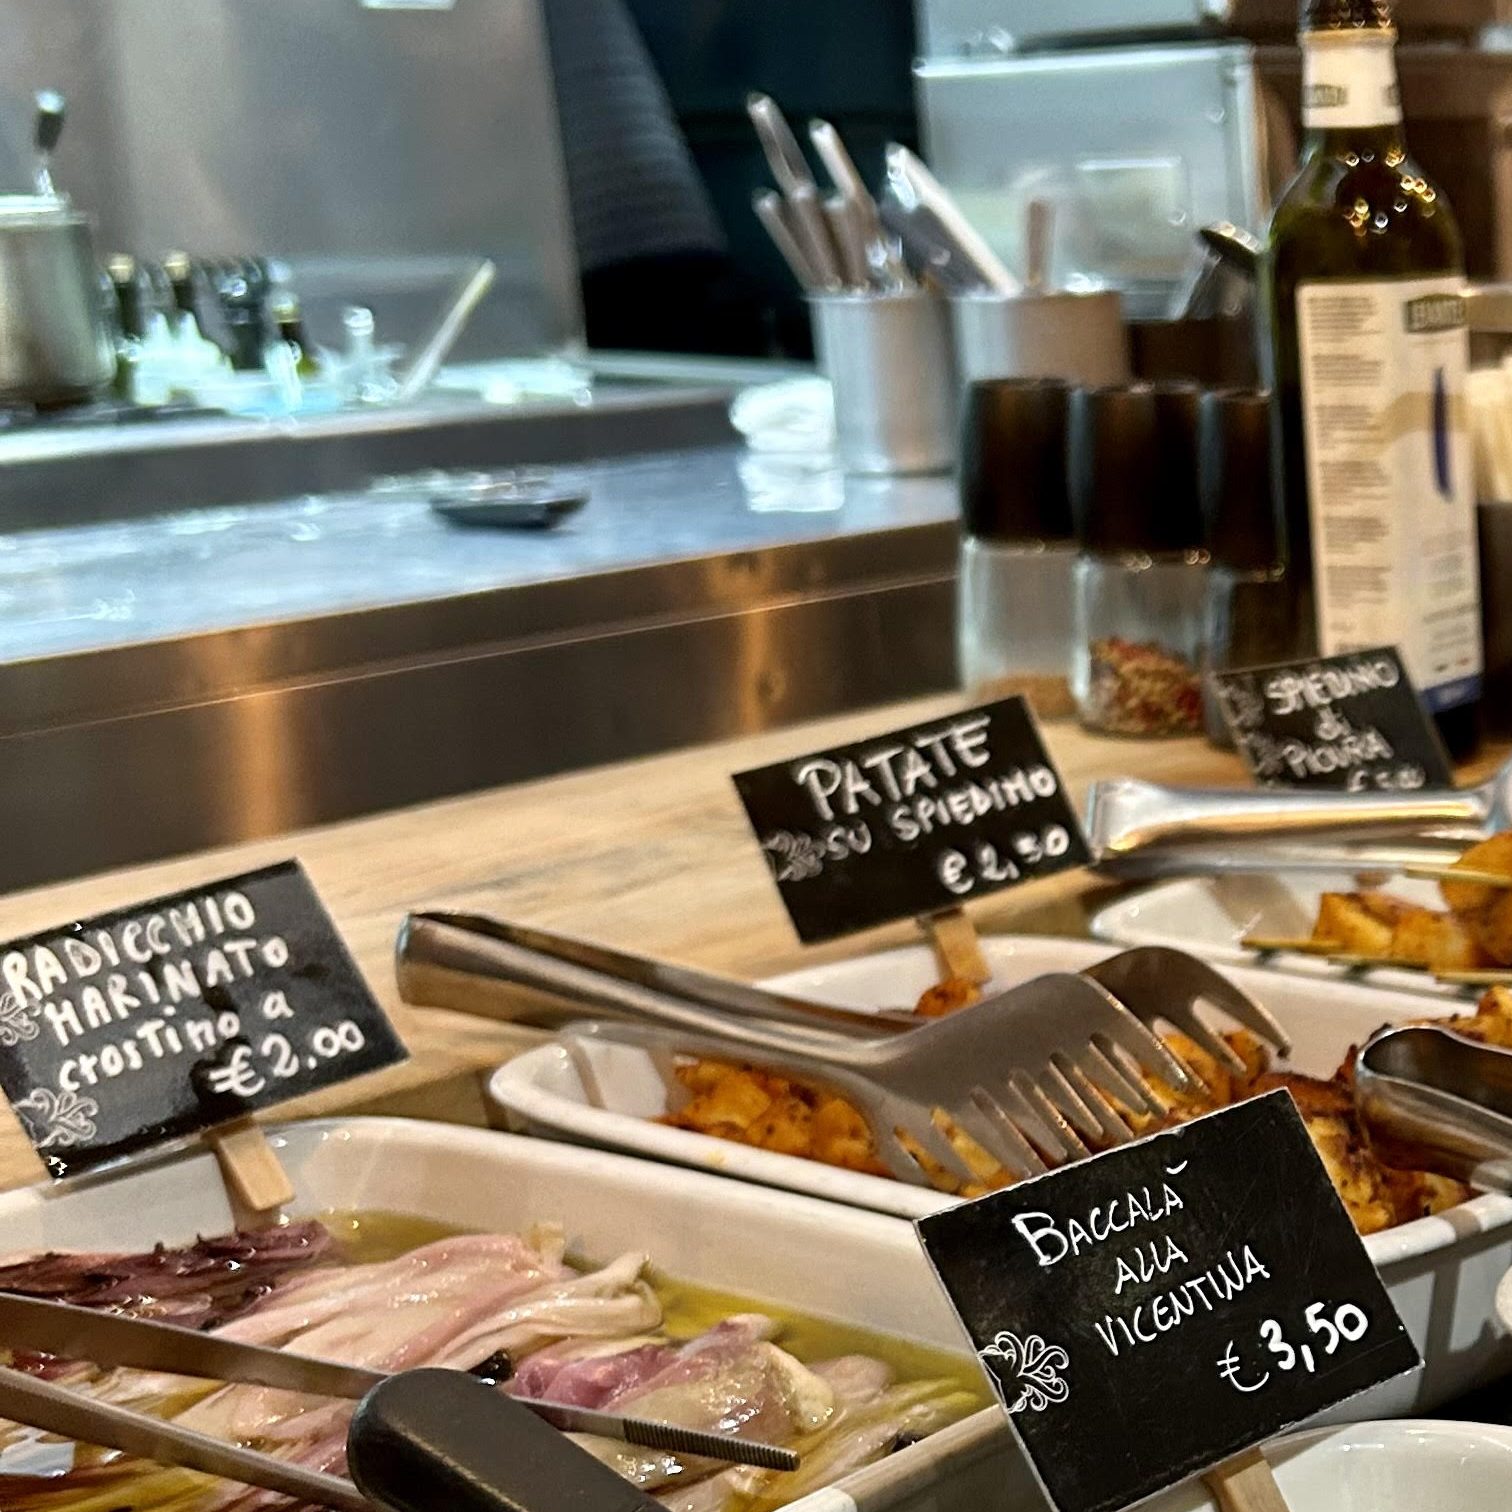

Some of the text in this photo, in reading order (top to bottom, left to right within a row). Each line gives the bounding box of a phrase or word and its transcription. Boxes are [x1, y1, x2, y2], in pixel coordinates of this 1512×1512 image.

[796, 714, 991, 820] PATATE
[2, 892, 256, 1001] RADICCHIO
[44, 936, 289, 1047] MARINATO
[263, 990, 294, 1019] a
[1095, 1244, 1271, 1357] VICENTINA
[1114, 1235, 1189, 1294] ALLA
